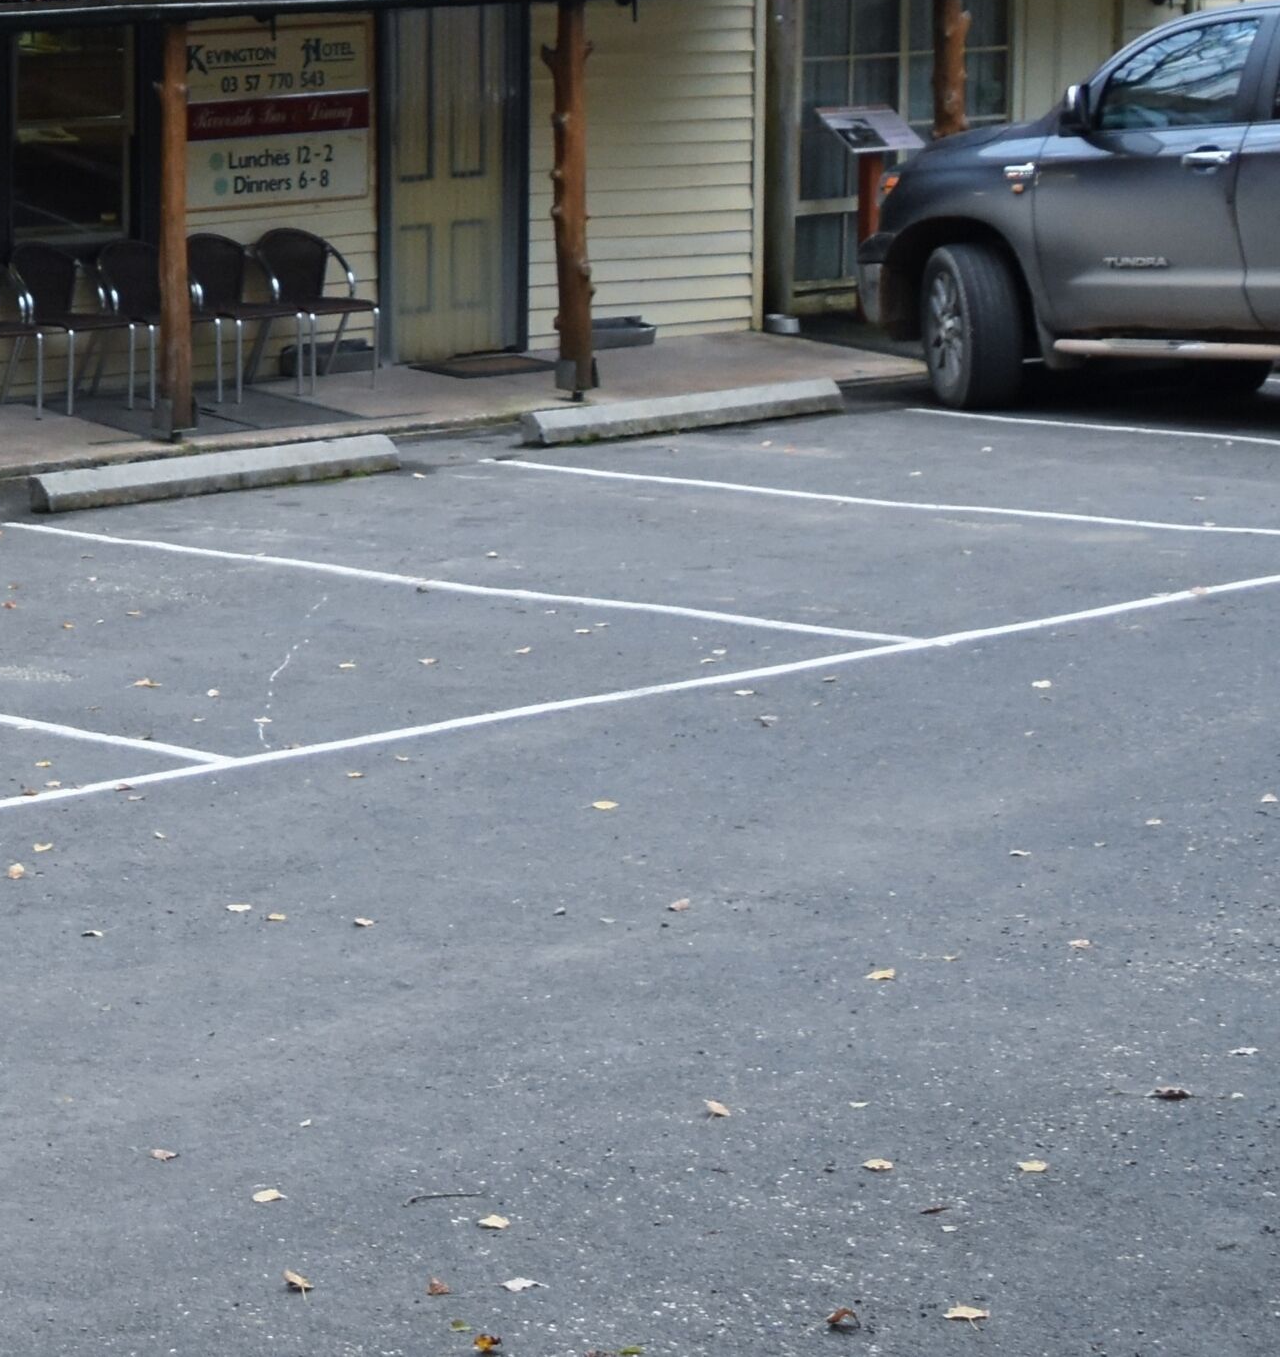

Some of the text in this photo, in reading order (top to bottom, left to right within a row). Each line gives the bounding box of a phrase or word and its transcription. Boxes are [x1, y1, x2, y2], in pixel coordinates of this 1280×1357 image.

[186, 44, 277, 75] KEVINGTON
[221, 70, 325, 94] 03 57 770 543
[227, 150, 291, 170] Lunches
[233, 175, 292, 194] Dinners
[1102, 256, 1168, 268] TUNDRA
